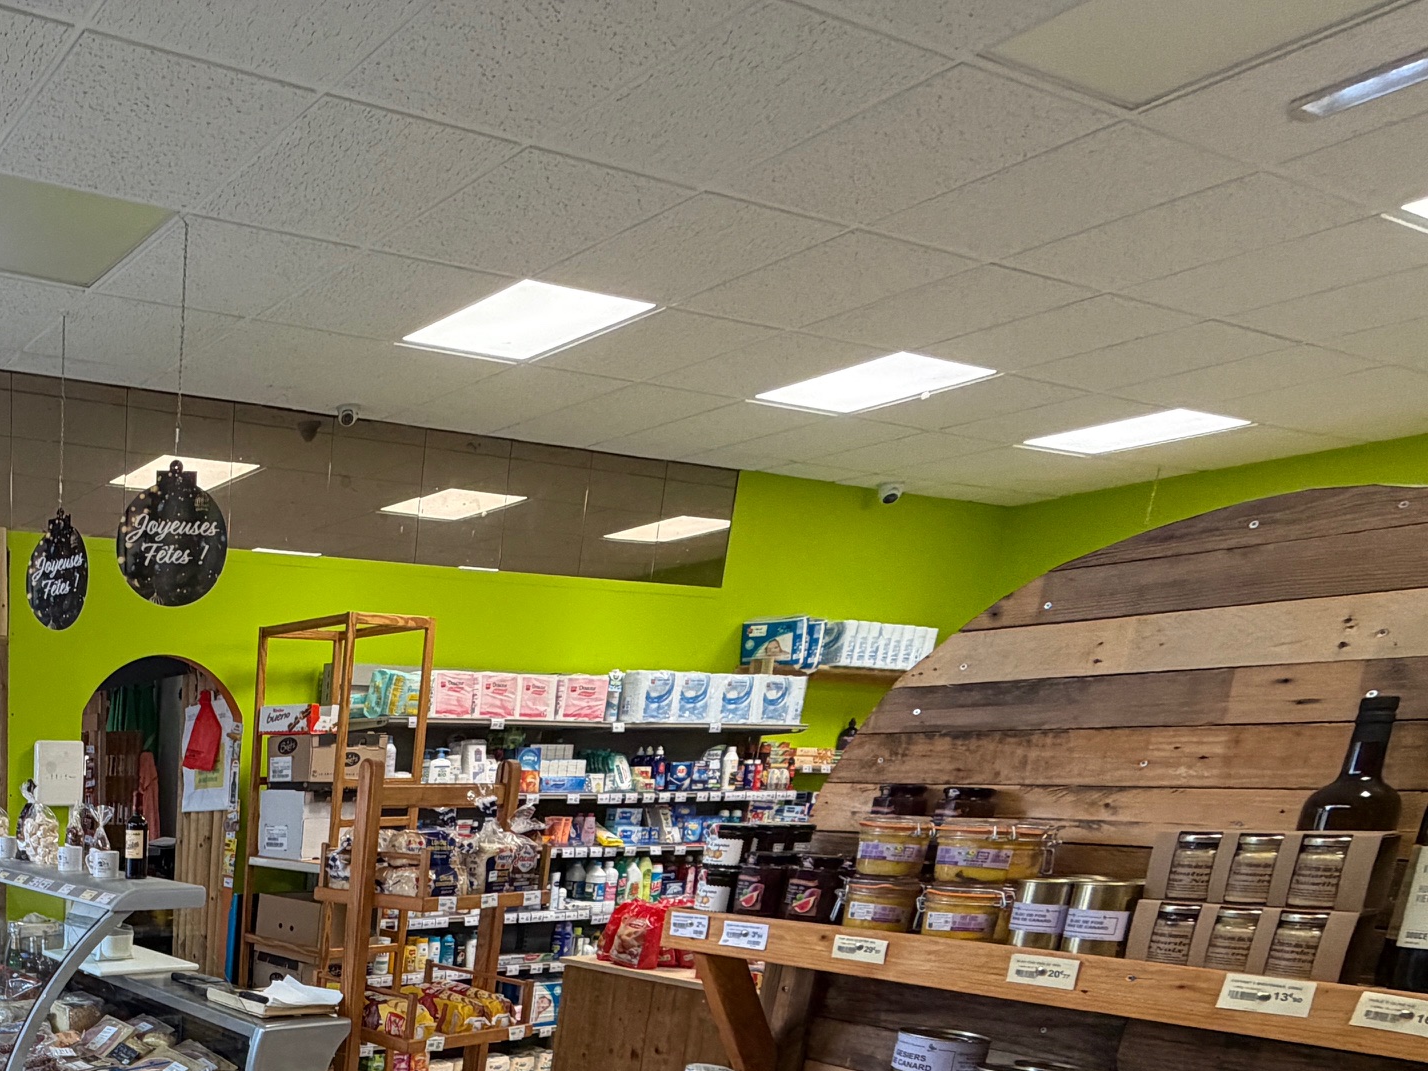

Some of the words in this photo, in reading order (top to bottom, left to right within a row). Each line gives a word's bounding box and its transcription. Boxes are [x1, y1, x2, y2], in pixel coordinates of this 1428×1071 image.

[126, 514, 219, 543] Joyeuses
[142, 542, 192, 566] Fêtes
[198, 545, 209, 565] !
[32, 552, 83, 581] Joyeuses
[42, 579, 70, 599] Fêtes
[73, 573, 79, 592] !
[267, 712, 290, 724] bueno
[896, 1049, 926, 1062] GESIERS
[898, 1059, 931, 1071] CANARD
